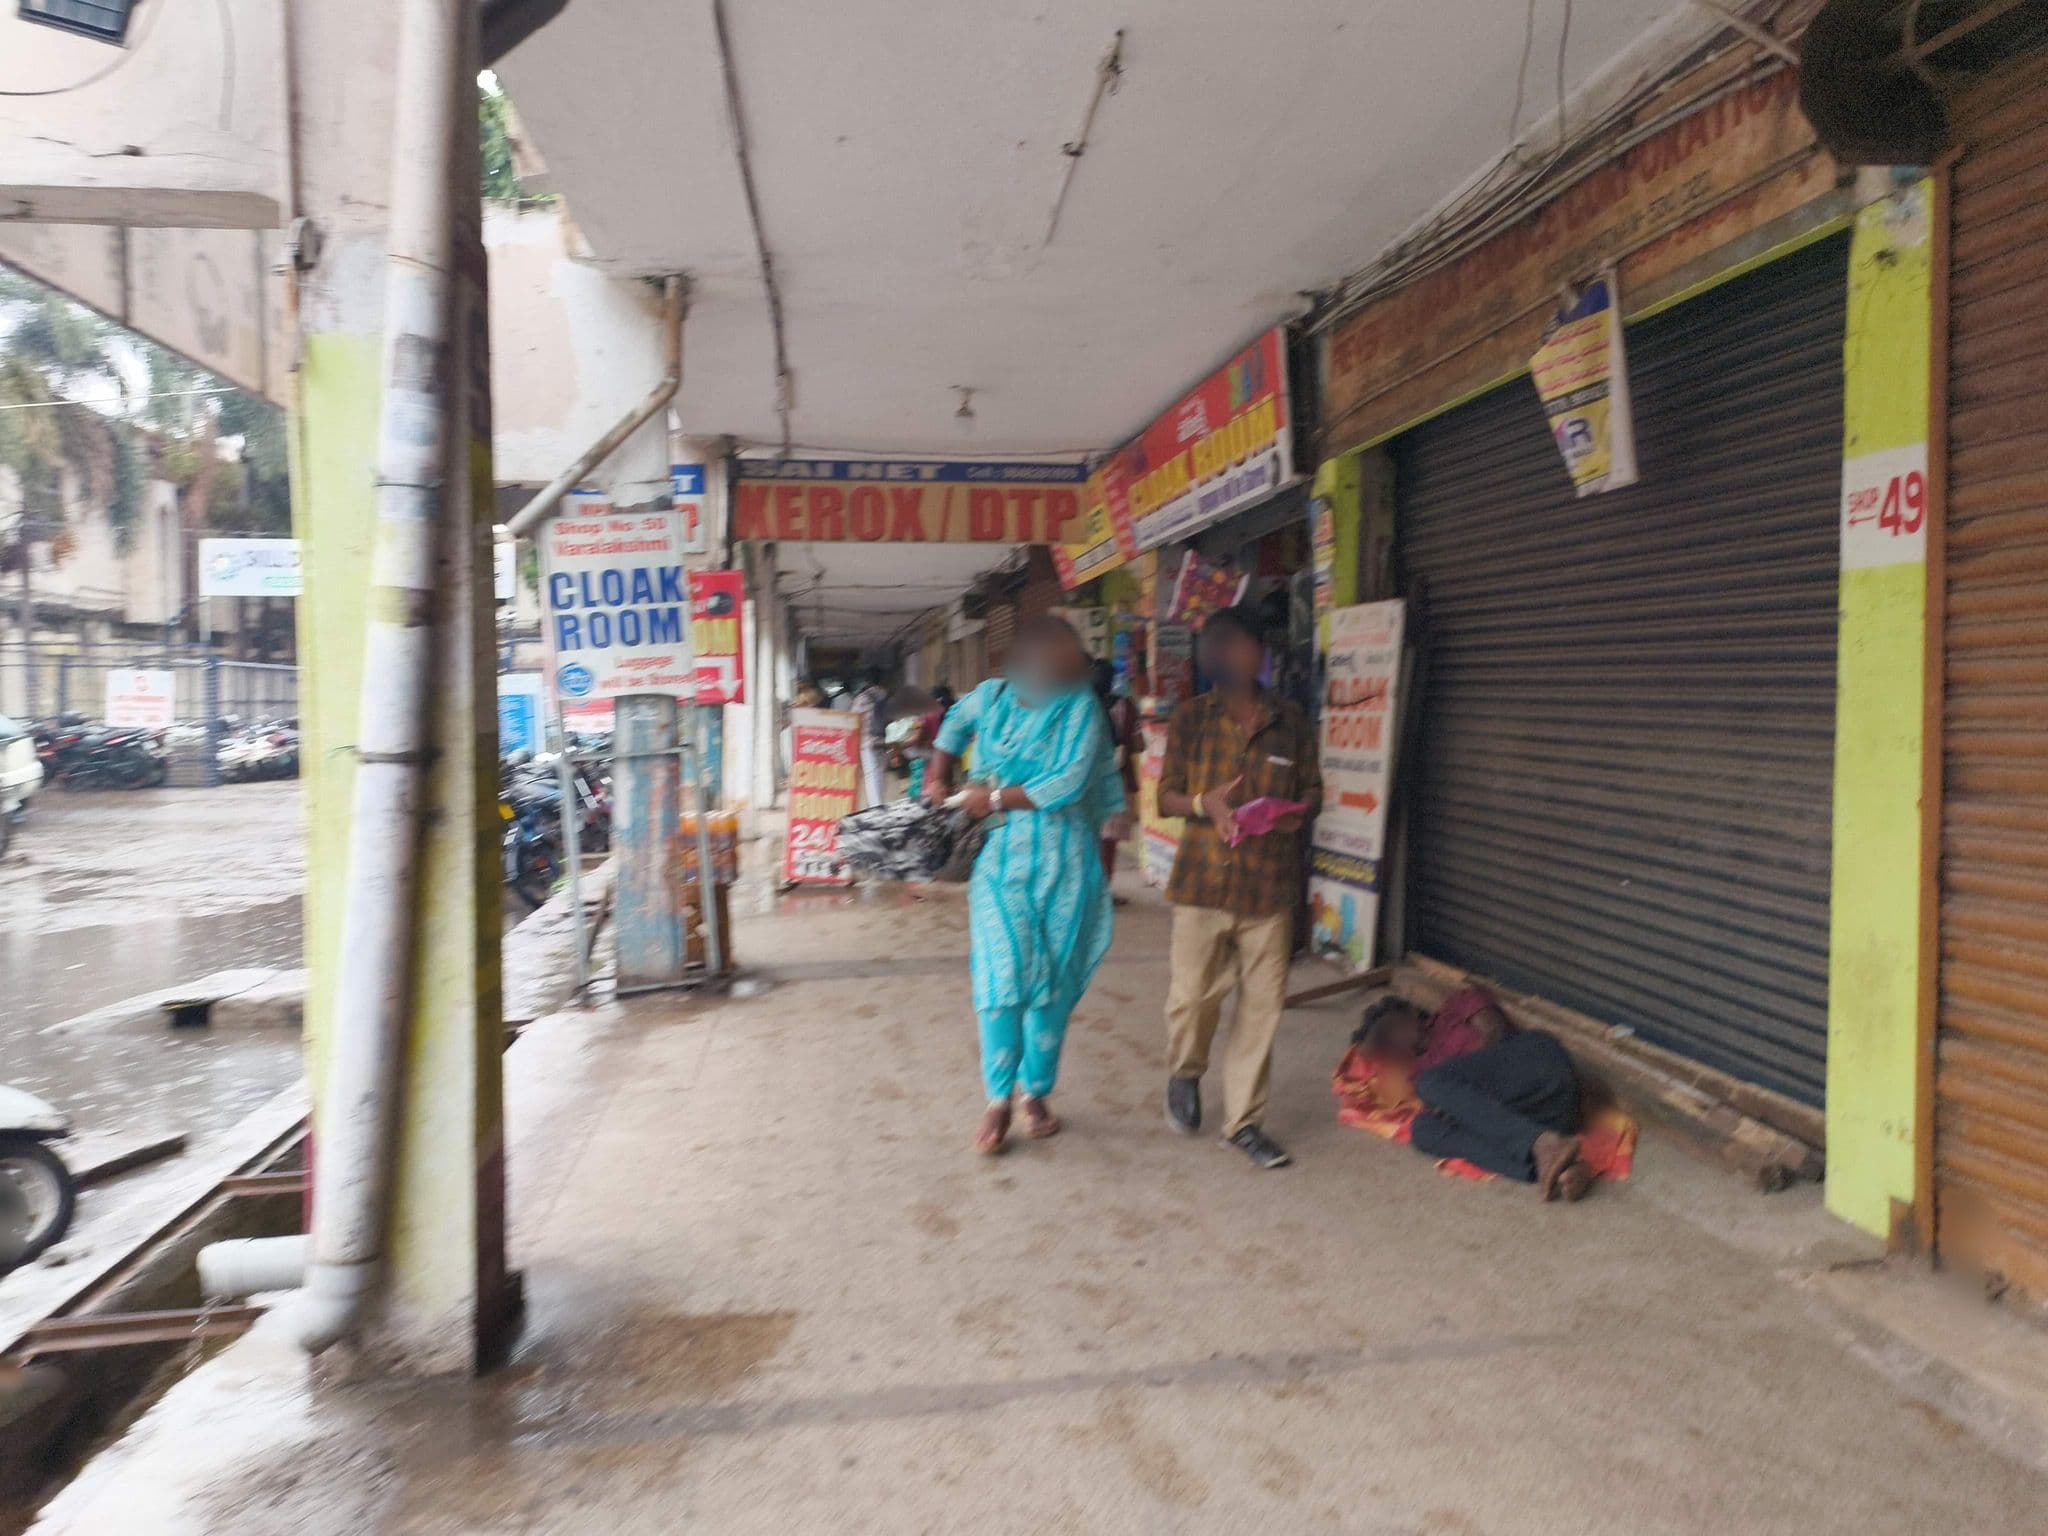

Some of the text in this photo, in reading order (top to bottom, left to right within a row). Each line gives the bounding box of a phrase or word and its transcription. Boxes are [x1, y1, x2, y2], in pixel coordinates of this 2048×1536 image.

[735, 484, 927, 542] XEROX
[968, 488, 1078, 542] DTP
[1879, 470, 1925, 537] 49
[549, 565, 684, 610] CLOAK
[555, 607, 683, 651] ROOM
